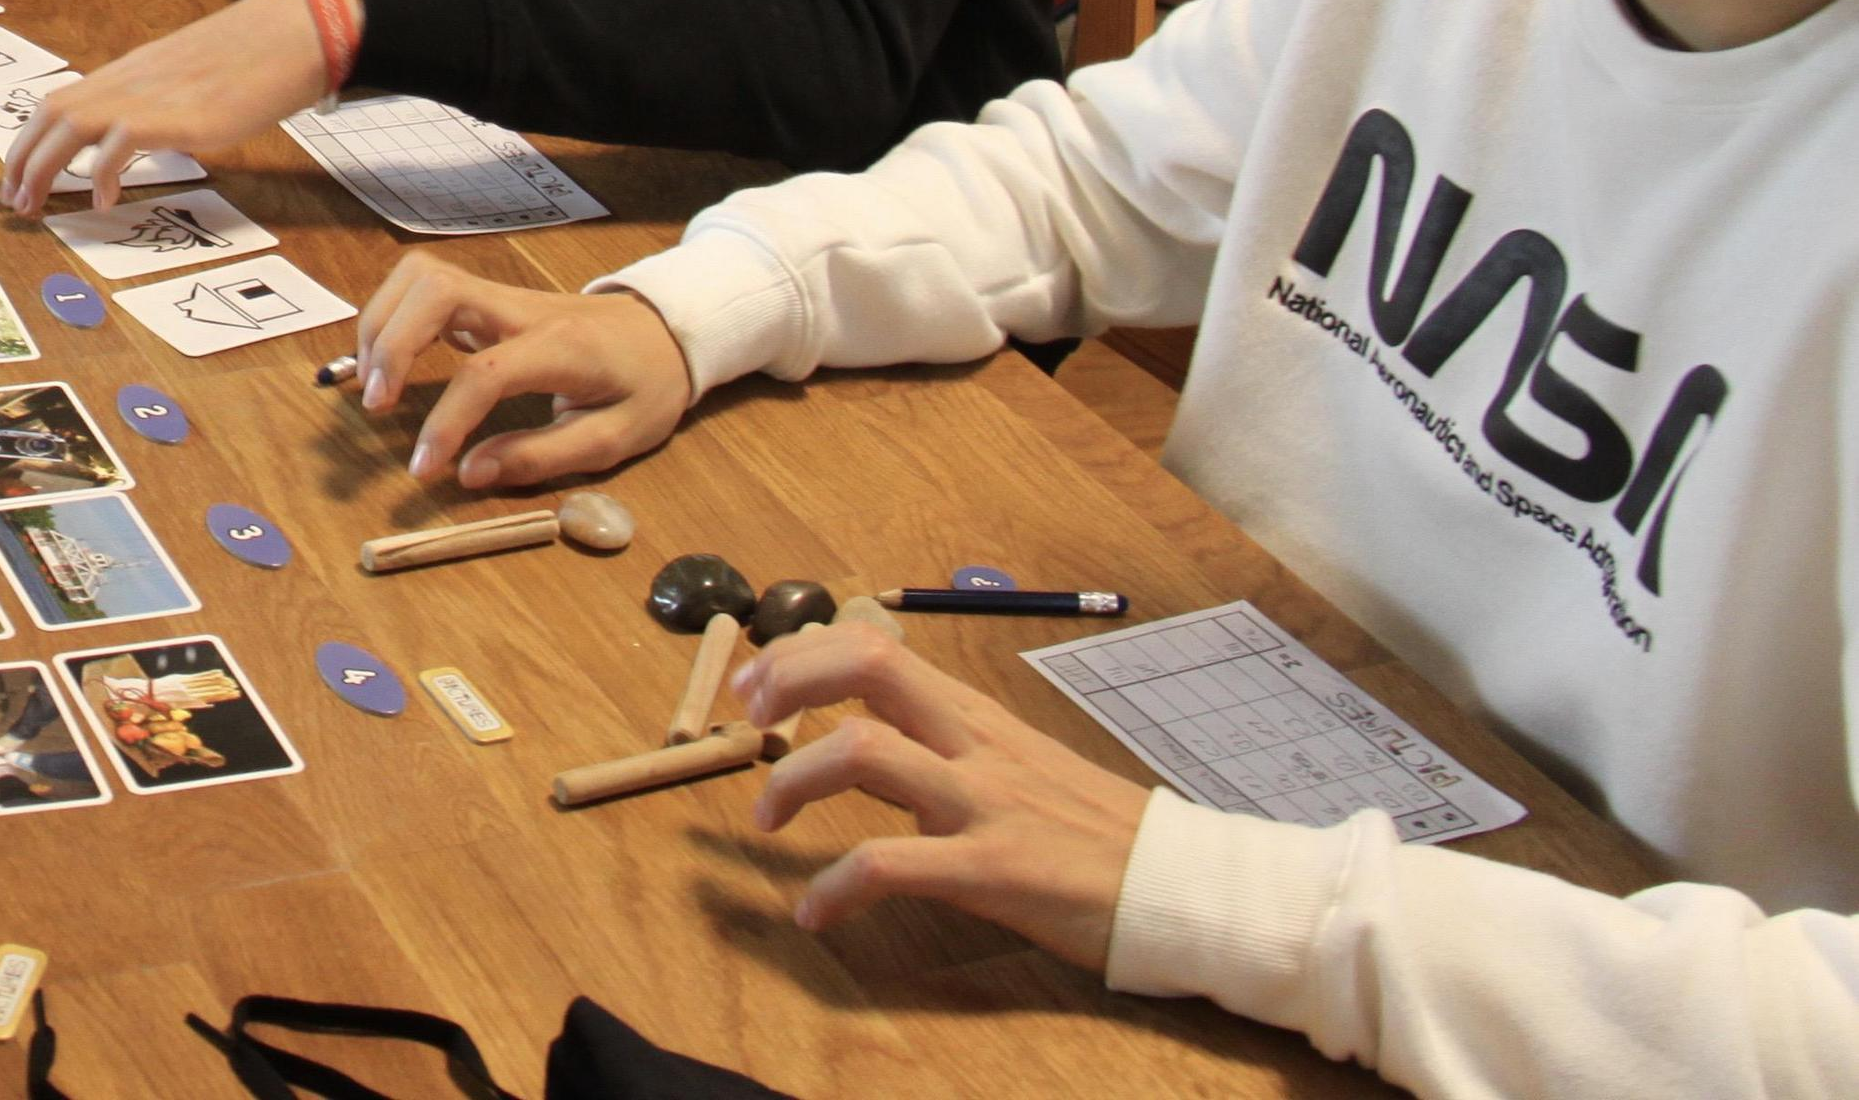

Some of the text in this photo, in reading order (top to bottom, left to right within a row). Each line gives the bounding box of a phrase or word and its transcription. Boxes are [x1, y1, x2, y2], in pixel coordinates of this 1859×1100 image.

[54, 291, 87, 303] 1
[1293, 107, 1730, 598] NASA
[133, 404, 169, 419] 2
[1267, 275, 1368, 357] National
[1461, 453, 1492, 491] and
[1493, 480, 1578, 545] Space
[228, 524, 264, 541] 3
[342, 668, 377, 685] 4
[1324, 690, 1463, 789] PICTURES
